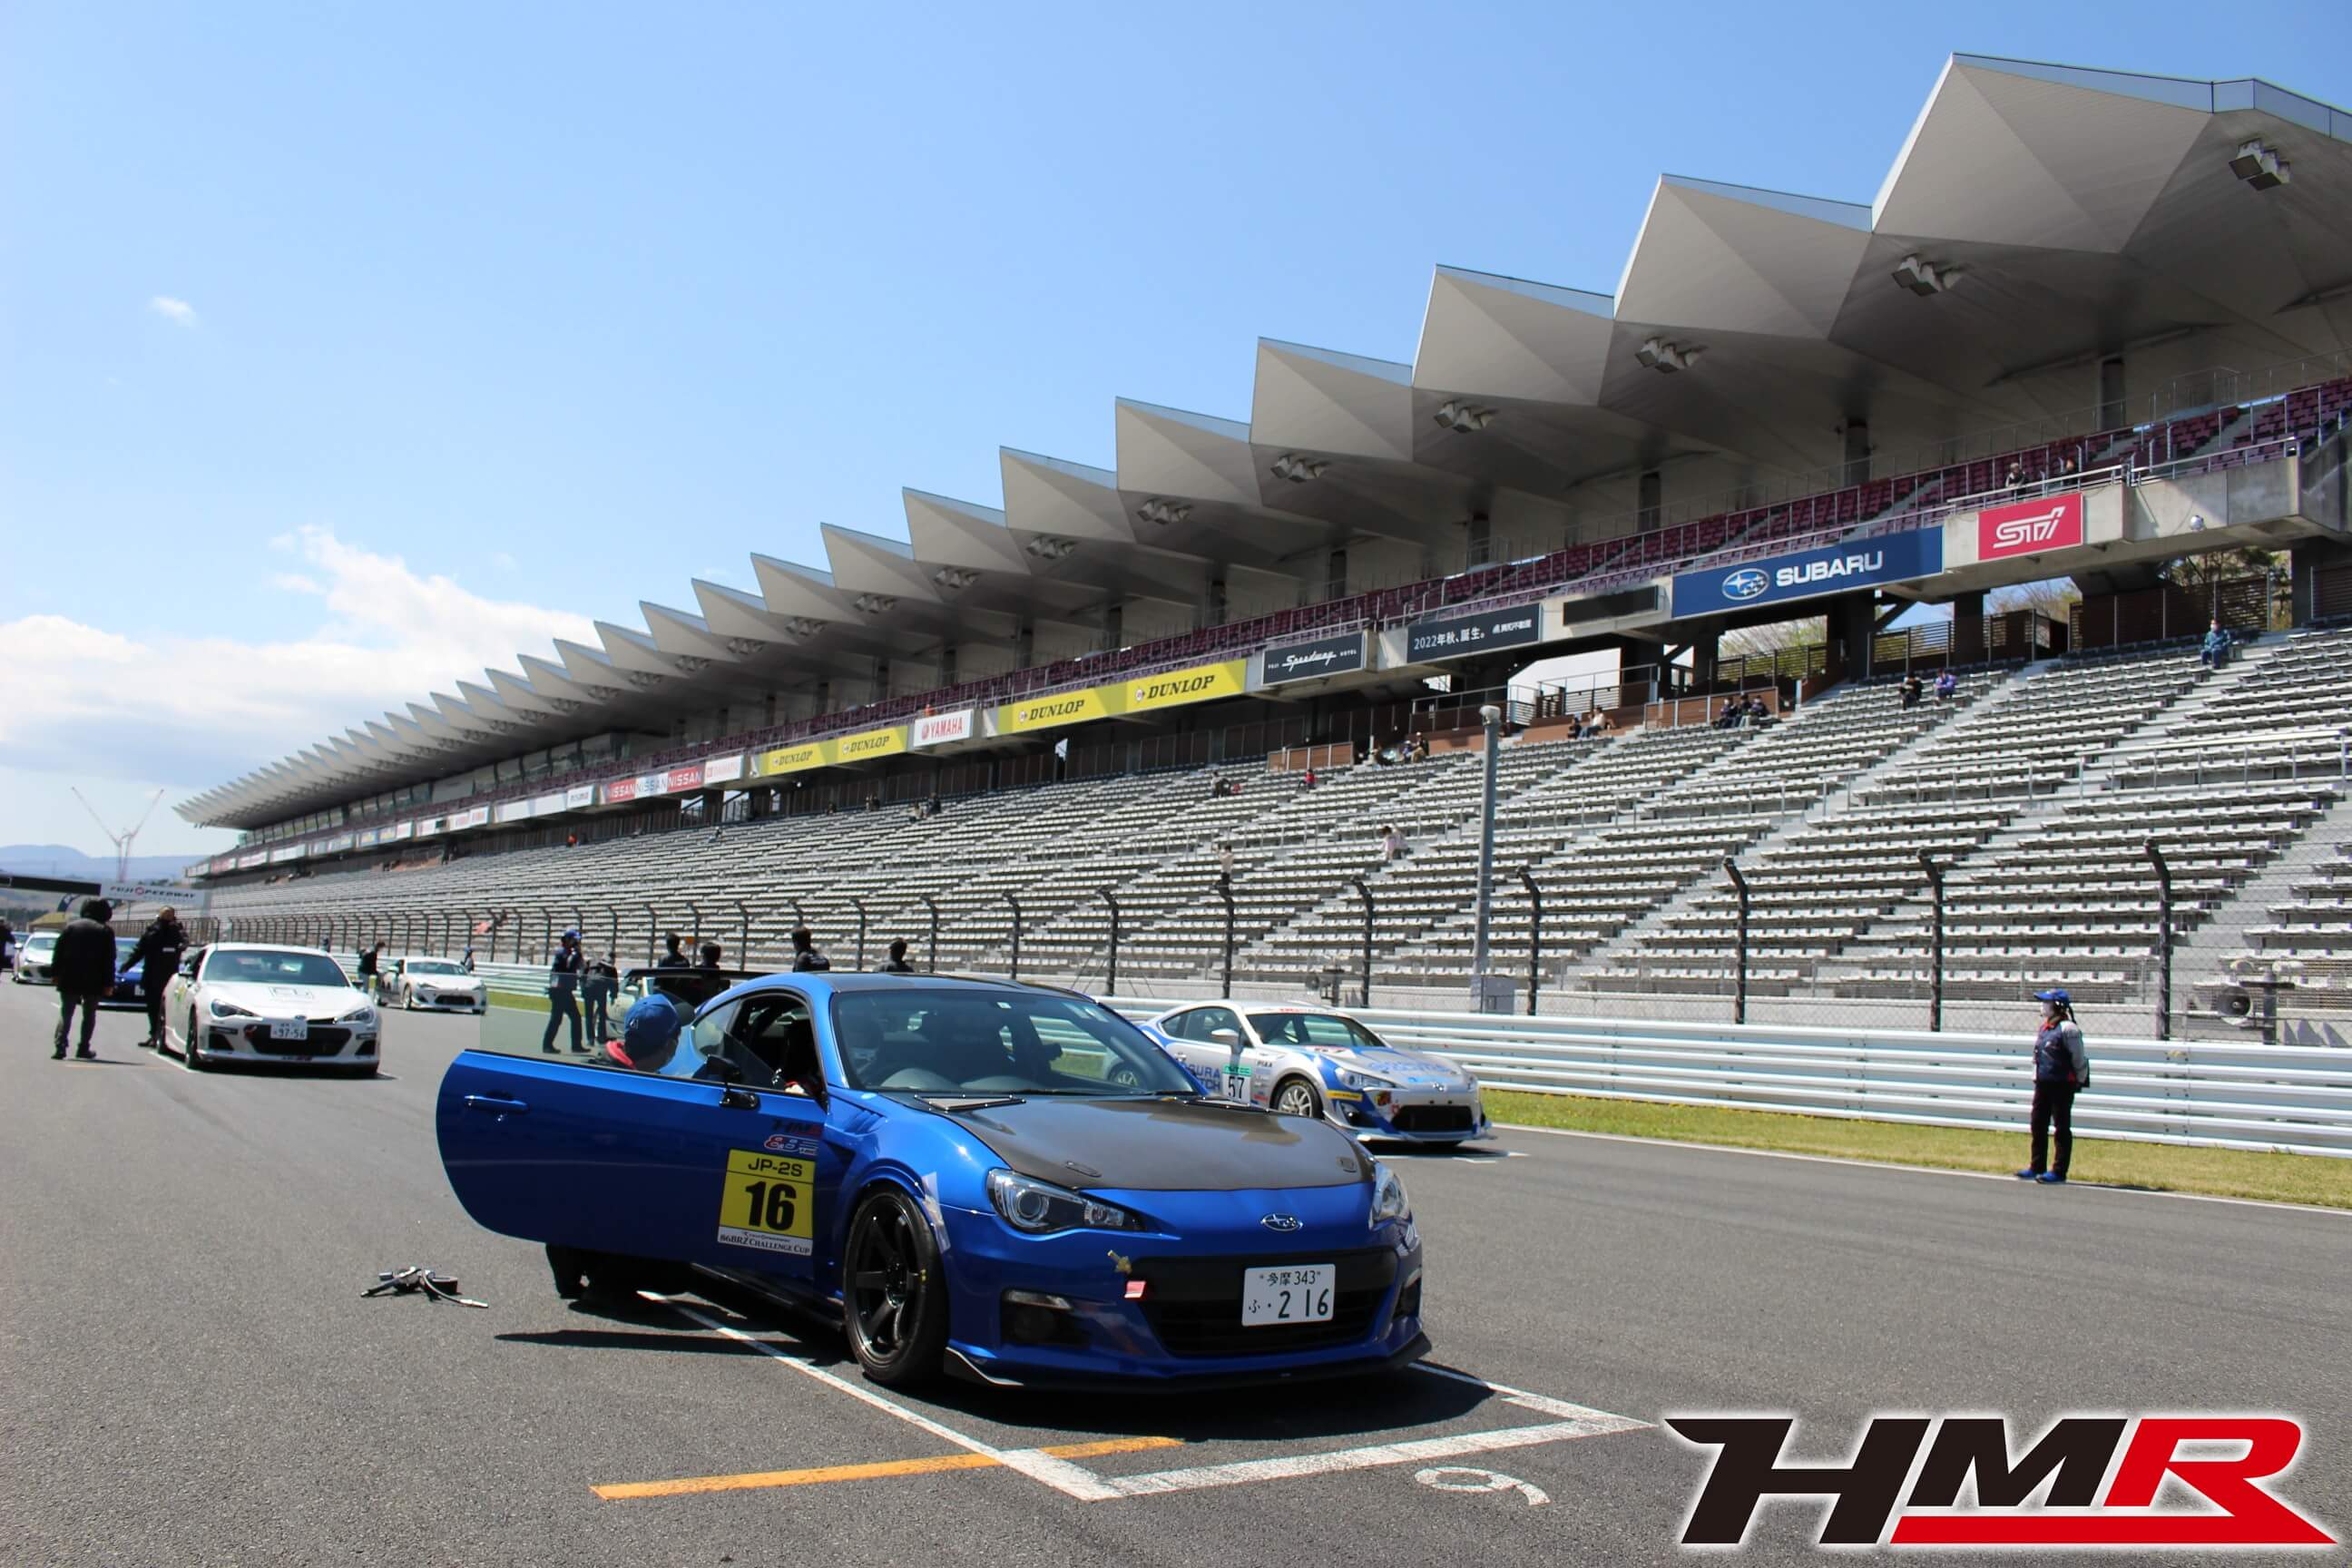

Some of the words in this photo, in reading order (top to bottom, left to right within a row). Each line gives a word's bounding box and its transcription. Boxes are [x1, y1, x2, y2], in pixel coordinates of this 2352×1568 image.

[1776, 551, 1883, 587] SUBARU
[1147, 675, 1215, 699] DUNLOP
[1029, 700, 1085, 720] DUNLOP
[929, 717, 964, 739] YAMAHA
[850, 736, 890, 753] DUNLOP
[779, 750, 813, 766] DUNLOP
[637, 776, 668, 795] NISSAN
[668, 770, 702, 788] NISSAN
[1228, 1075, 1245, 1100] 57
[748, 1158, 803, 1177] JP-2S
[746, 1181, 797, 1231] 16
[1267, 1272, 1291, 1287] 多摩
[1294, 1270, 1316, 1285] 343
[1249, 1299, 1260, 1313] ふ
